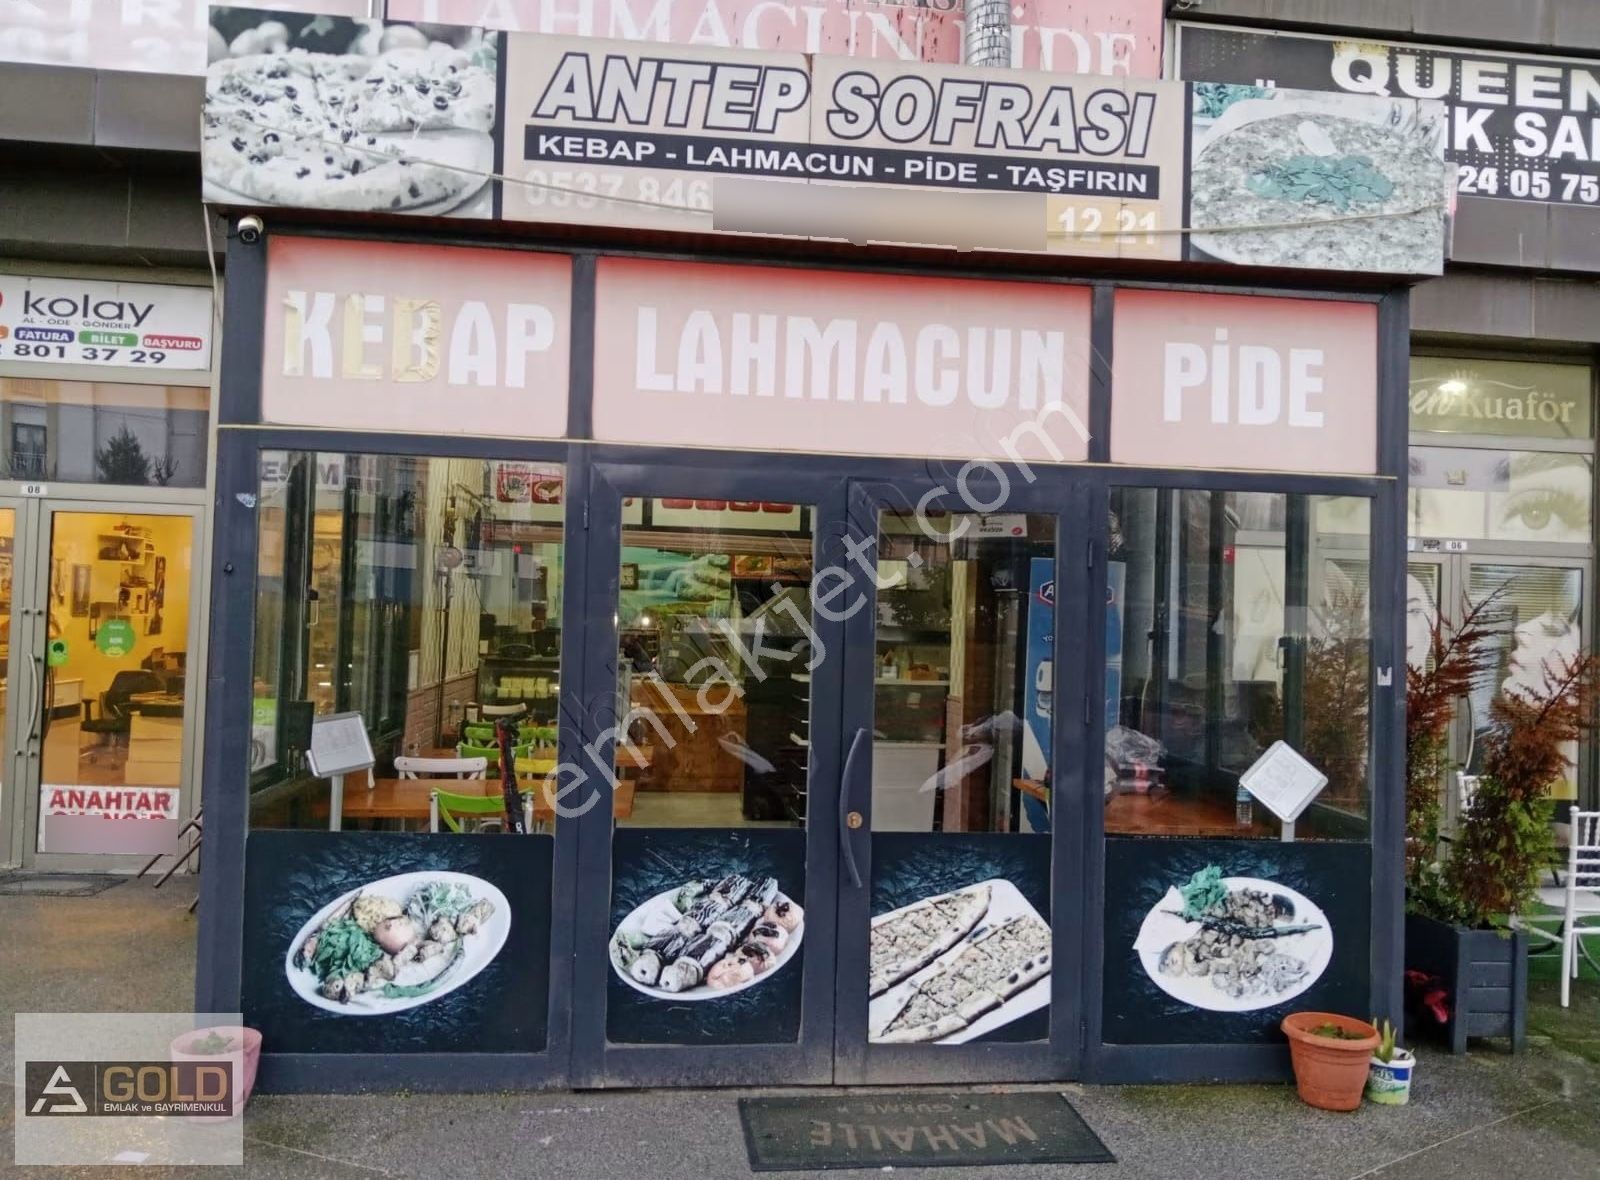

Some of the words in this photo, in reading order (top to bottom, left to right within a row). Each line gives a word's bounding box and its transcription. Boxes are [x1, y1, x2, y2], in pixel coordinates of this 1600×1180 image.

[951, 5, 1137, 77] İDE
[1330, 50, 1600, 112] QUEEN
[533, 52, 811, 134] ANTEP
[825, 71, 1156, 158] SOFRASI
[538, 135, 656, 162] KEBAP
[686, 145, 874, 177] LAHMACUN
[903, 156, 978, 183] PİDE
[1005, 166, 1148, 193] TAŞFIRIN
[523, 169, 625, 209] 0537
[636, 177, 710, 213] 846
[1509, 169, 1551, 199] 05
[1560, 173, 1600, 204] 75
[1057, 207, 1102, 242] 12
[1115, 210, 1157, 246] 21
[23, 290, 155, 328] kolay
[13, 343, 66, 359] 801
[81, 347, 119, 361] 37
[129, 350, 166, 364] 29
[18, 330, 70, 342] FATURA
[90, 333, 126, 345] BİLET
[143, 338, 201, 350] BAŞVURU
[282, 290, 555, 389] KEBAP
[634, 305, 1065, 411] LAHMACUN
[1161, 327, 1325, 428] PİDE
[27, 485, 41, 494] 08
[49, 789, 171, 812] ANAHTAR
[810, 1115, 1038, 1151] MAHALLE
